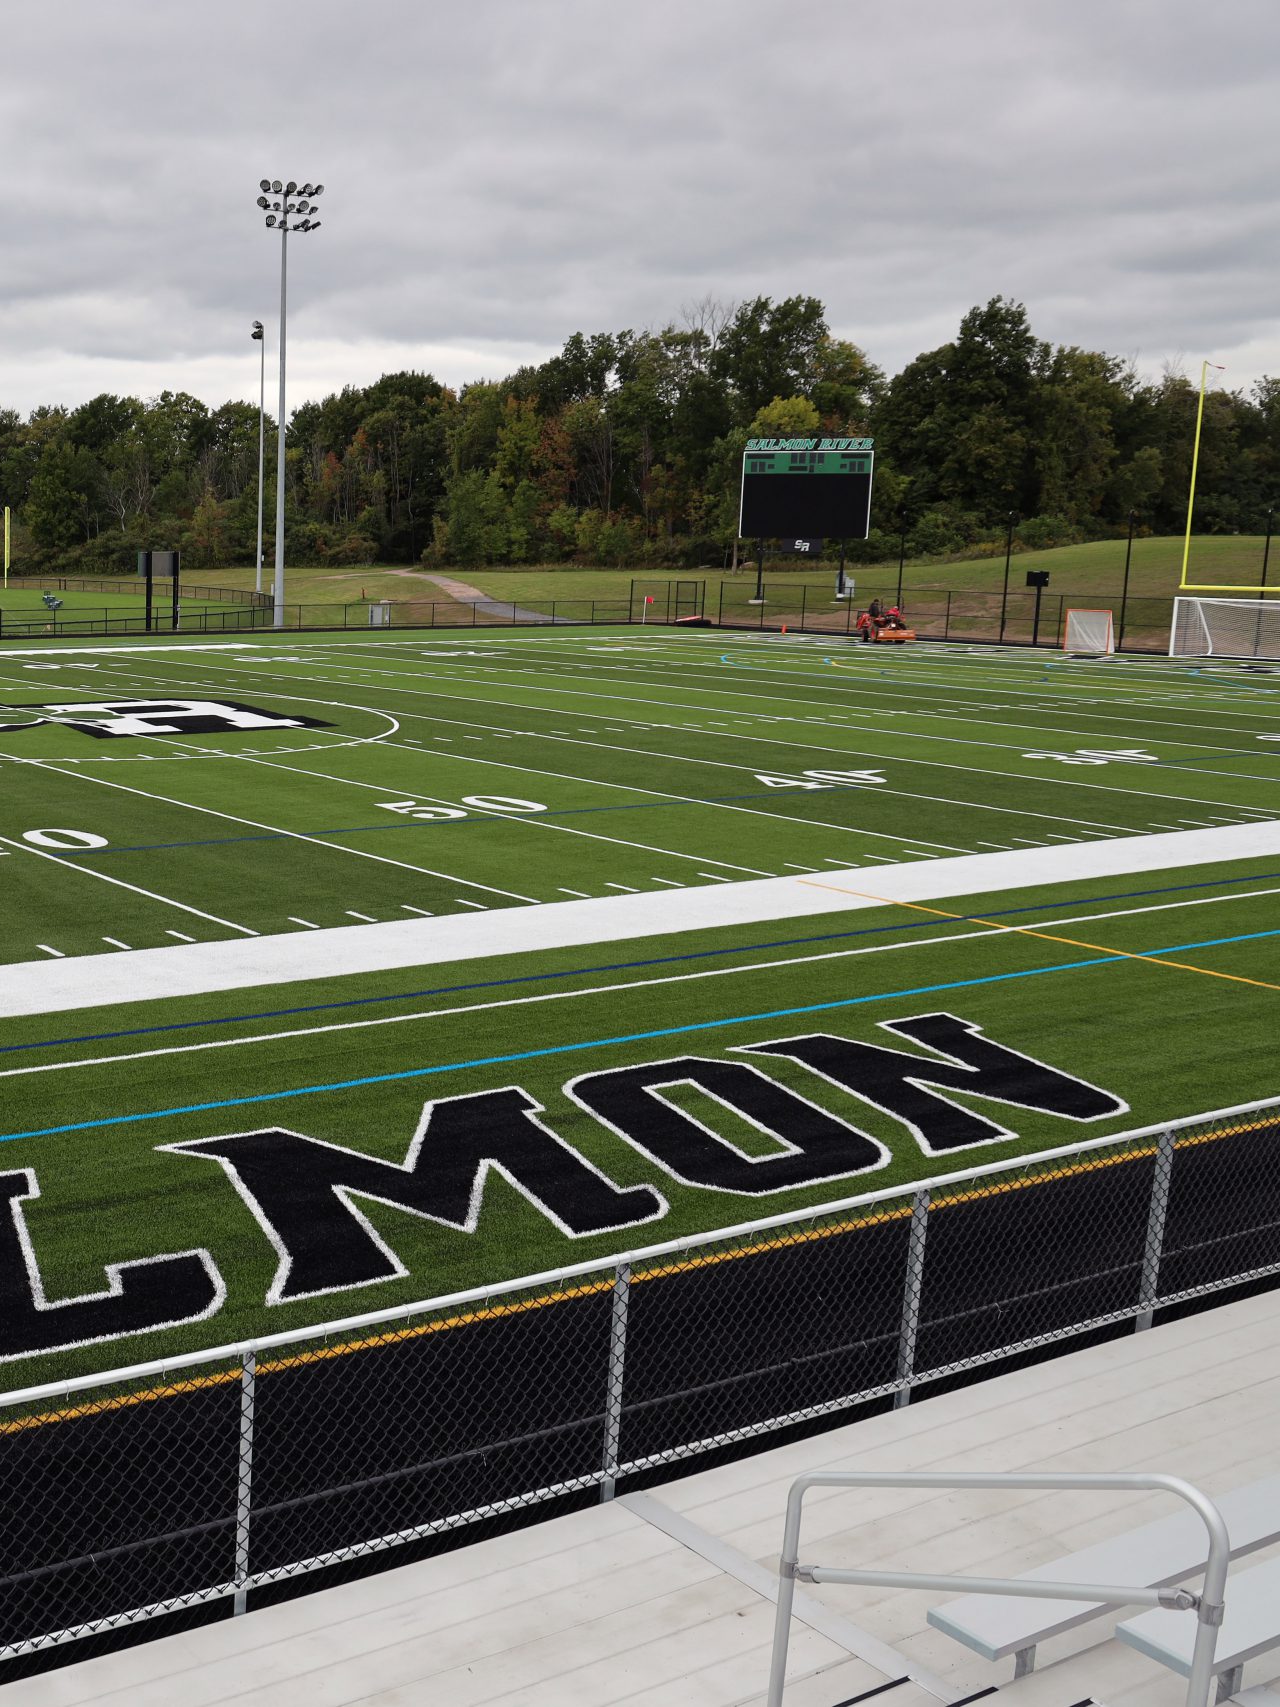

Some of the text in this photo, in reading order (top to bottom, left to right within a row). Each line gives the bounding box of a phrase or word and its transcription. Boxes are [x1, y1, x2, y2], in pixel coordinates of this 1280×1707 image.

[744, 438, 875, 450] SALMON RIVER
[1021, 750, 1160, 766] 30
[753, 769, 888, 790] 40
[373, 795, 548, 820] 50
